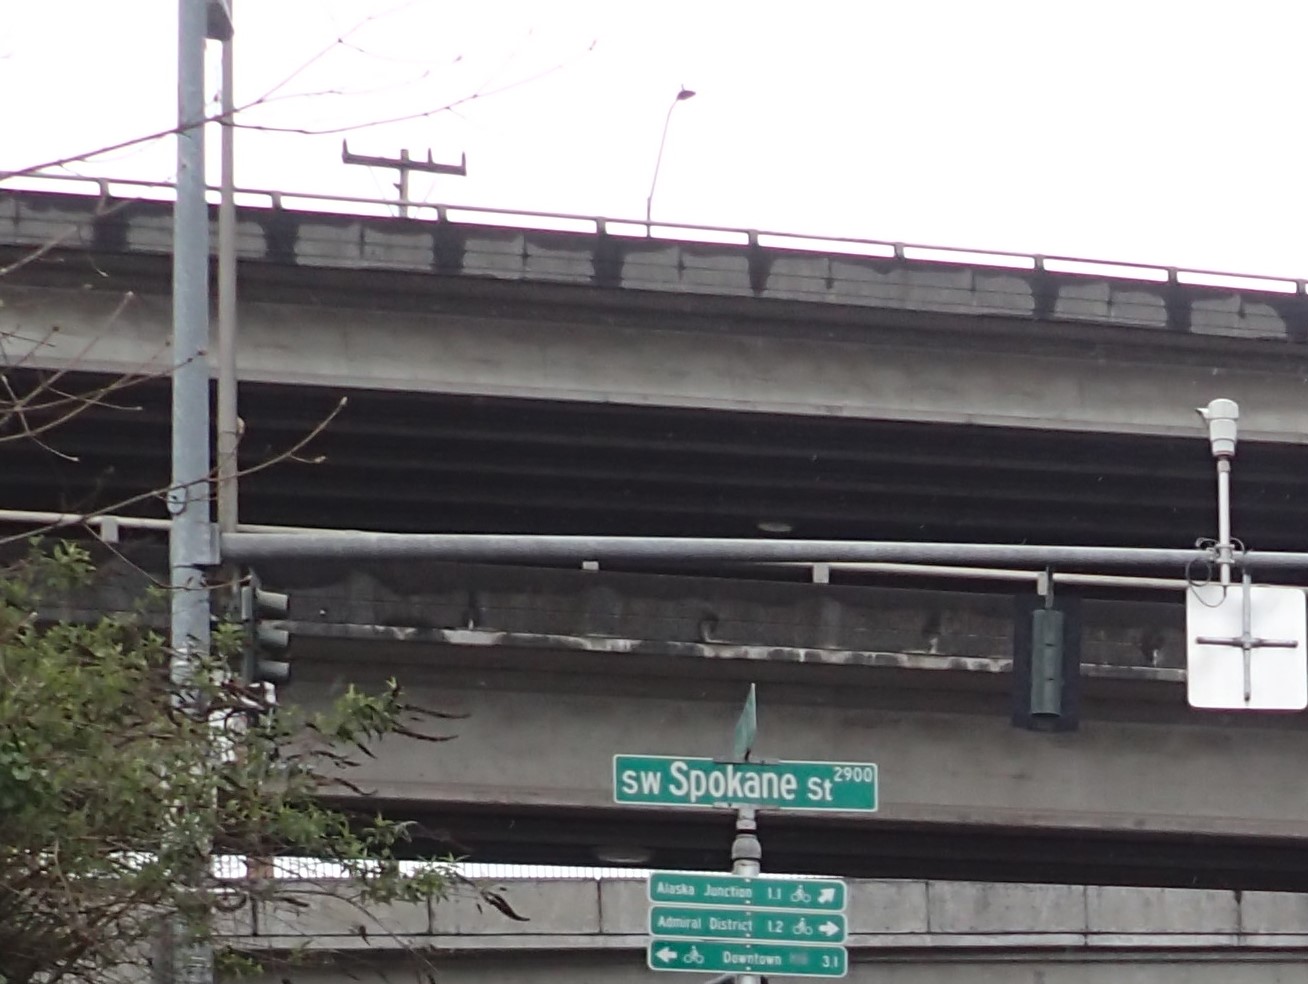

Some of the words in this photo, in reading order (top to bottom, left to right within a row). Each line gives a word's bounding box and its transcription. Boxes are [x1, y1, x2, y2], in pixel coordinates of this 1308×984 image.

[622, 770, 661, 795] SW
[669, 761, 798, 803] Spokane
[807, 777, 833, 801] St
[834, 766, 873, 782] 2900
[656, 882, 695, 896] Alaska
[704, 884, 752, 898] Junction
[768, 887, 782, 900] 1.1
[657, 915, 702, 930] Admiral
[709, 918, 752, 932] District
[768, 920, 784, 933] 1.2
[723, 951, 782, 966] Downtown
[822, 956, 839, 968] 3.1
